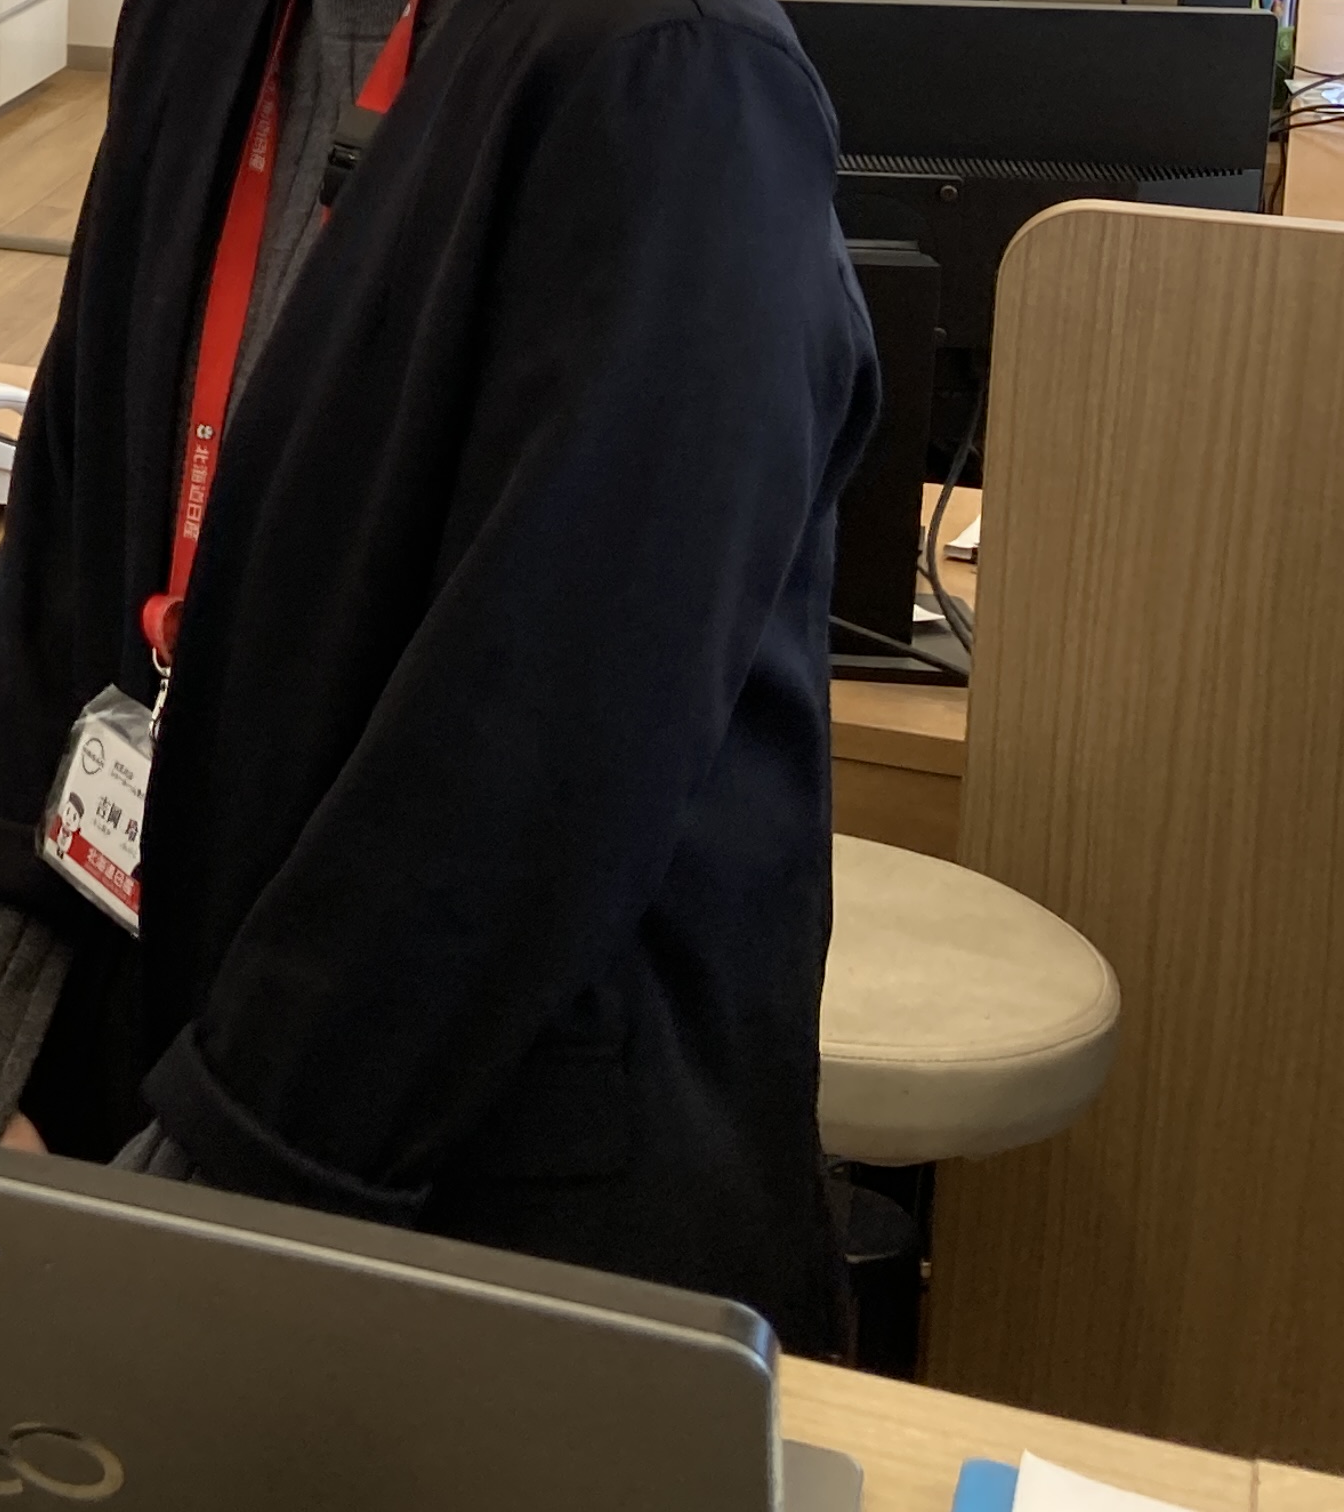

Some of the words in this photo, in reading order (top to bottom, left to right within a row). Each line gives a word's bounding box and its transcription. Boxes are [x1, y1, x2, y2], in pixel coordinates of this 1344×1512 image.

[183, 445, 210, 542] 北海道日産
